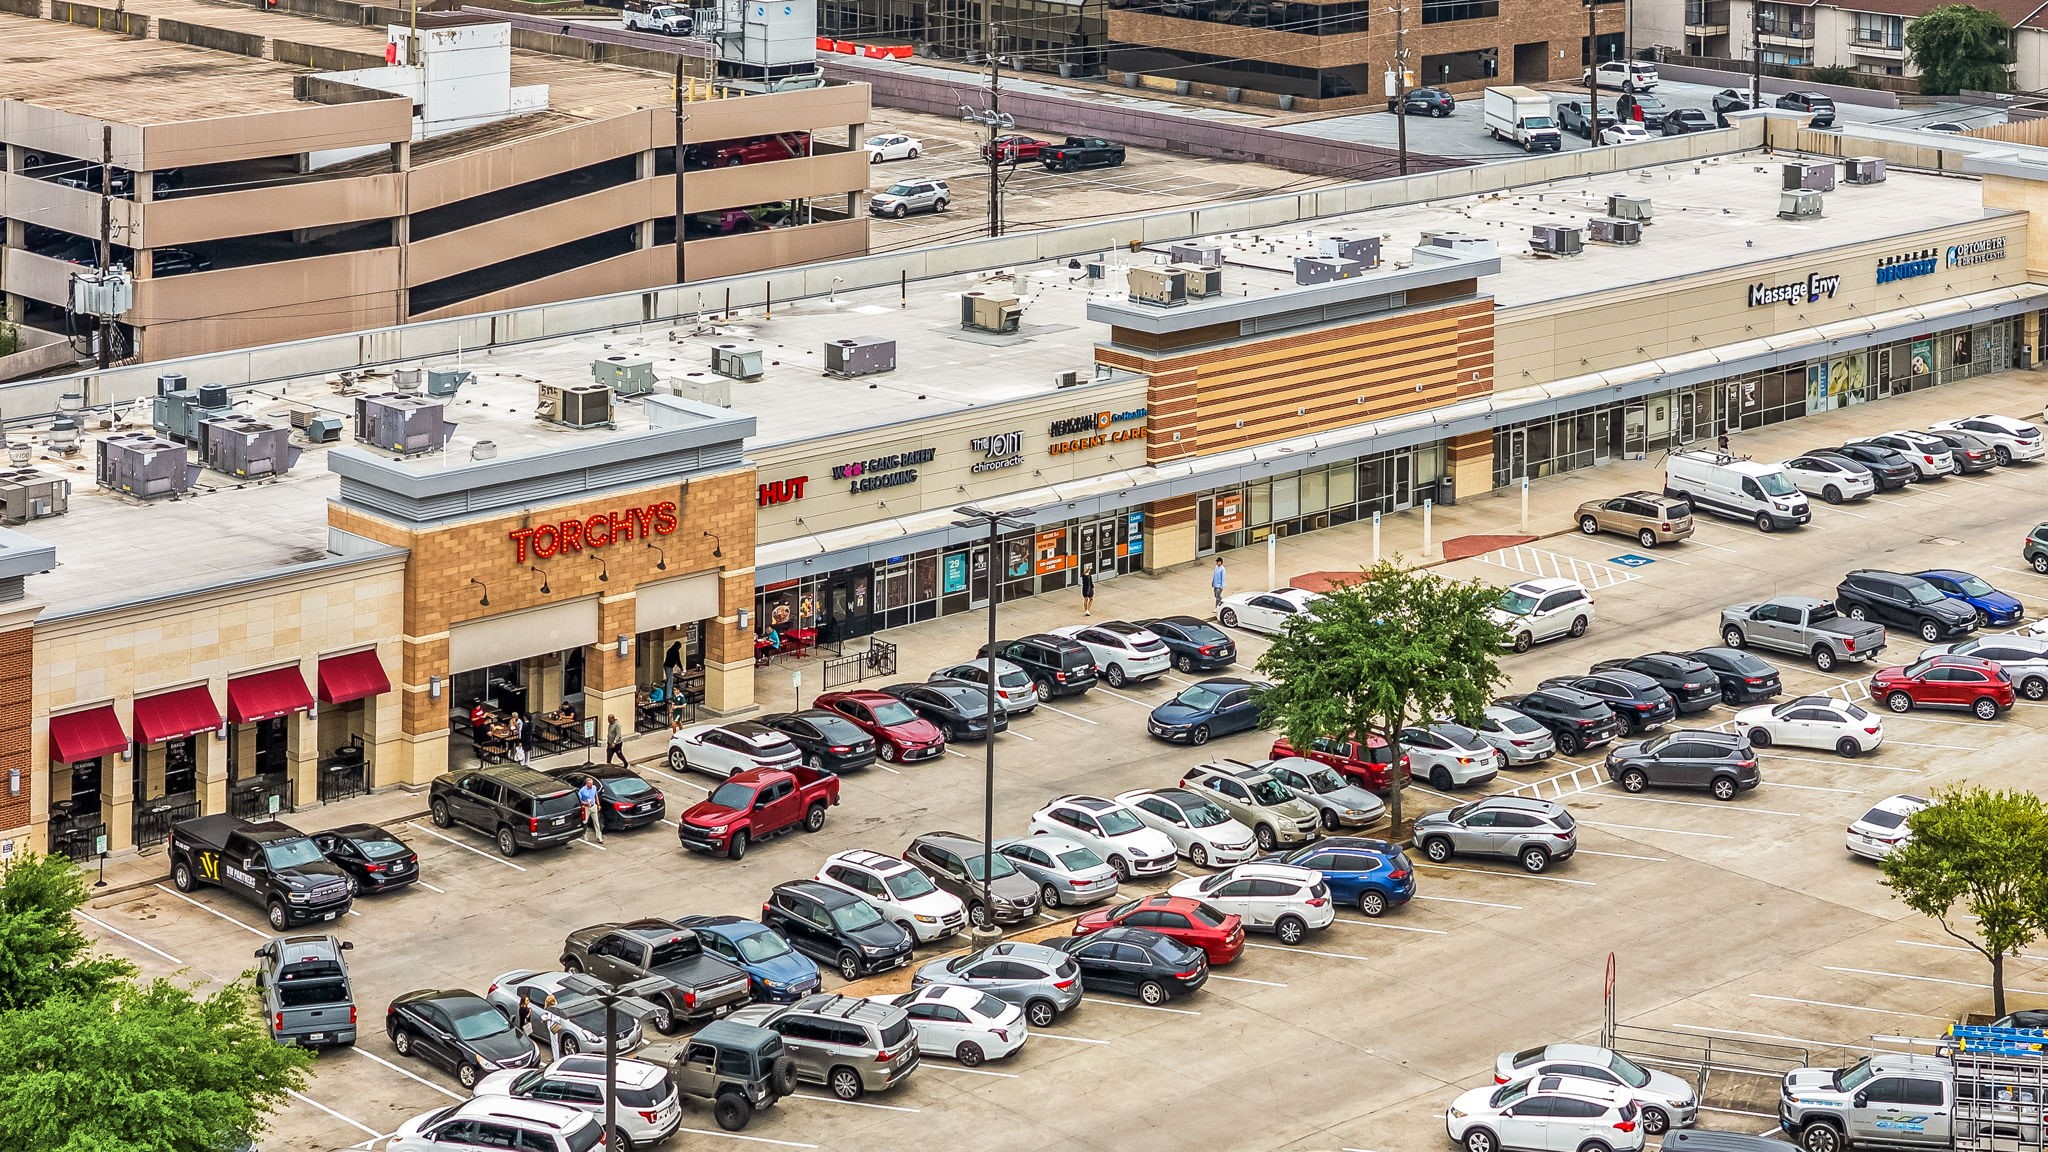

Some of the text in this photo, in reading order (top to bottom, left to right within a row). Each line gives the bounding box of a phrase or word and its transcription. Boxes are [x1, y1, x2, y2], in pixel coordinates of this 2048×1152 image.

[1878, 248, 1938, 266] SUPREME
[1957, 237, 2006, 255] OPTOMETRY
[1876, 258, 1938, 284] DENTISTRY
[1748, 272, 1840, 307] Massage Envy
[970, 430, 1025, 458] THE JOINT
[1049, 426, 1147, 456] URGENT CARE
[868, 455, 900, 473] GANG
[900, 447, 937, 467] BAKERY
[971, 455, 1025, 474] chiropractic
[759, 475, 809, 507] HUT
[850, 469, 917, 495] & GROOMING
[509, 501, 677, 563] TORCHYS
[233, 868, 256, 886] PARTNERS
